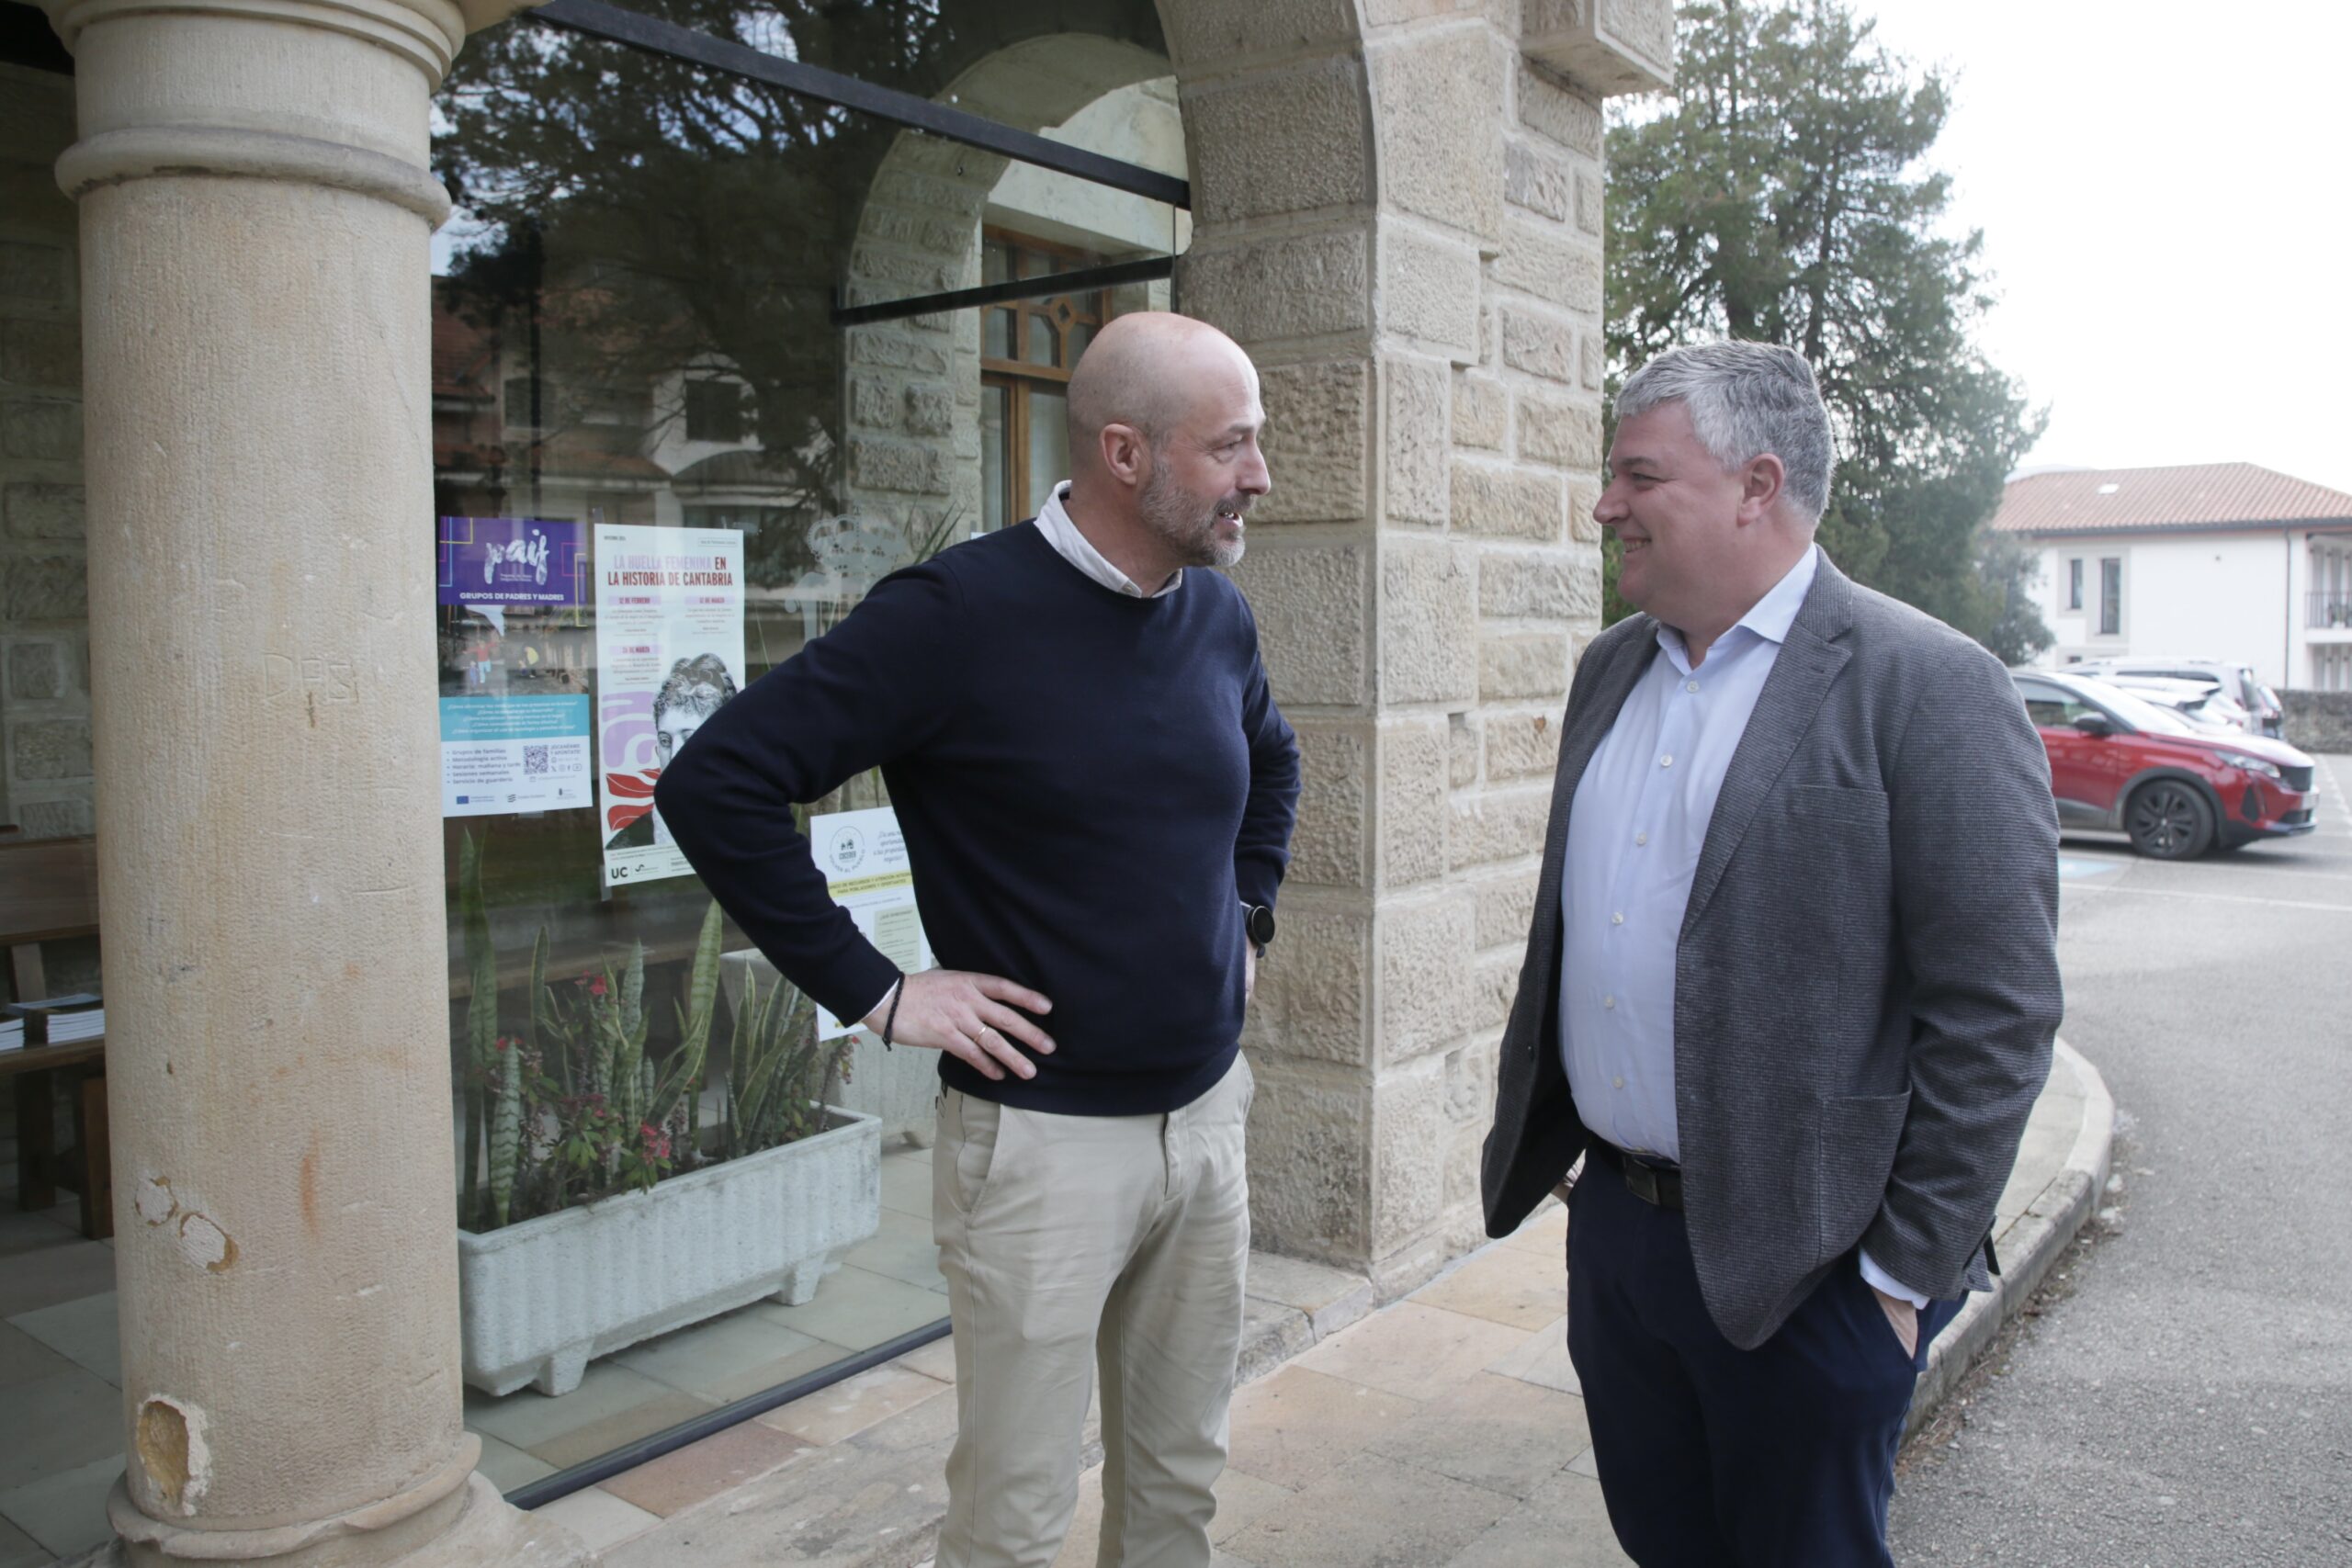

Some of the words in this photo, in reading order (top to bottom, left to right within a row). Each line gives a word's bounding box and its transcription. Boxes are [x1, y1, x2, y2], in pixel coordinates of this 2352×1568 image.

[614, 555, 625, 570] LA
[628, 555, 662, 570] HUELLA
[665, 555, 712, 570] FEMENINA
[715, 556, 727, 570] EN
[607, 571, 619, 586] LA
[622, 571, 665, 586] HISTORIA
[668, 571, 680, 586] DE
[683, 571, 733, 587] CANTABRIA
[459, 592, 493, 600] GRUPOS
[505, 592, 532, 601] PADRES
[611, 866, 628, 879] UC
